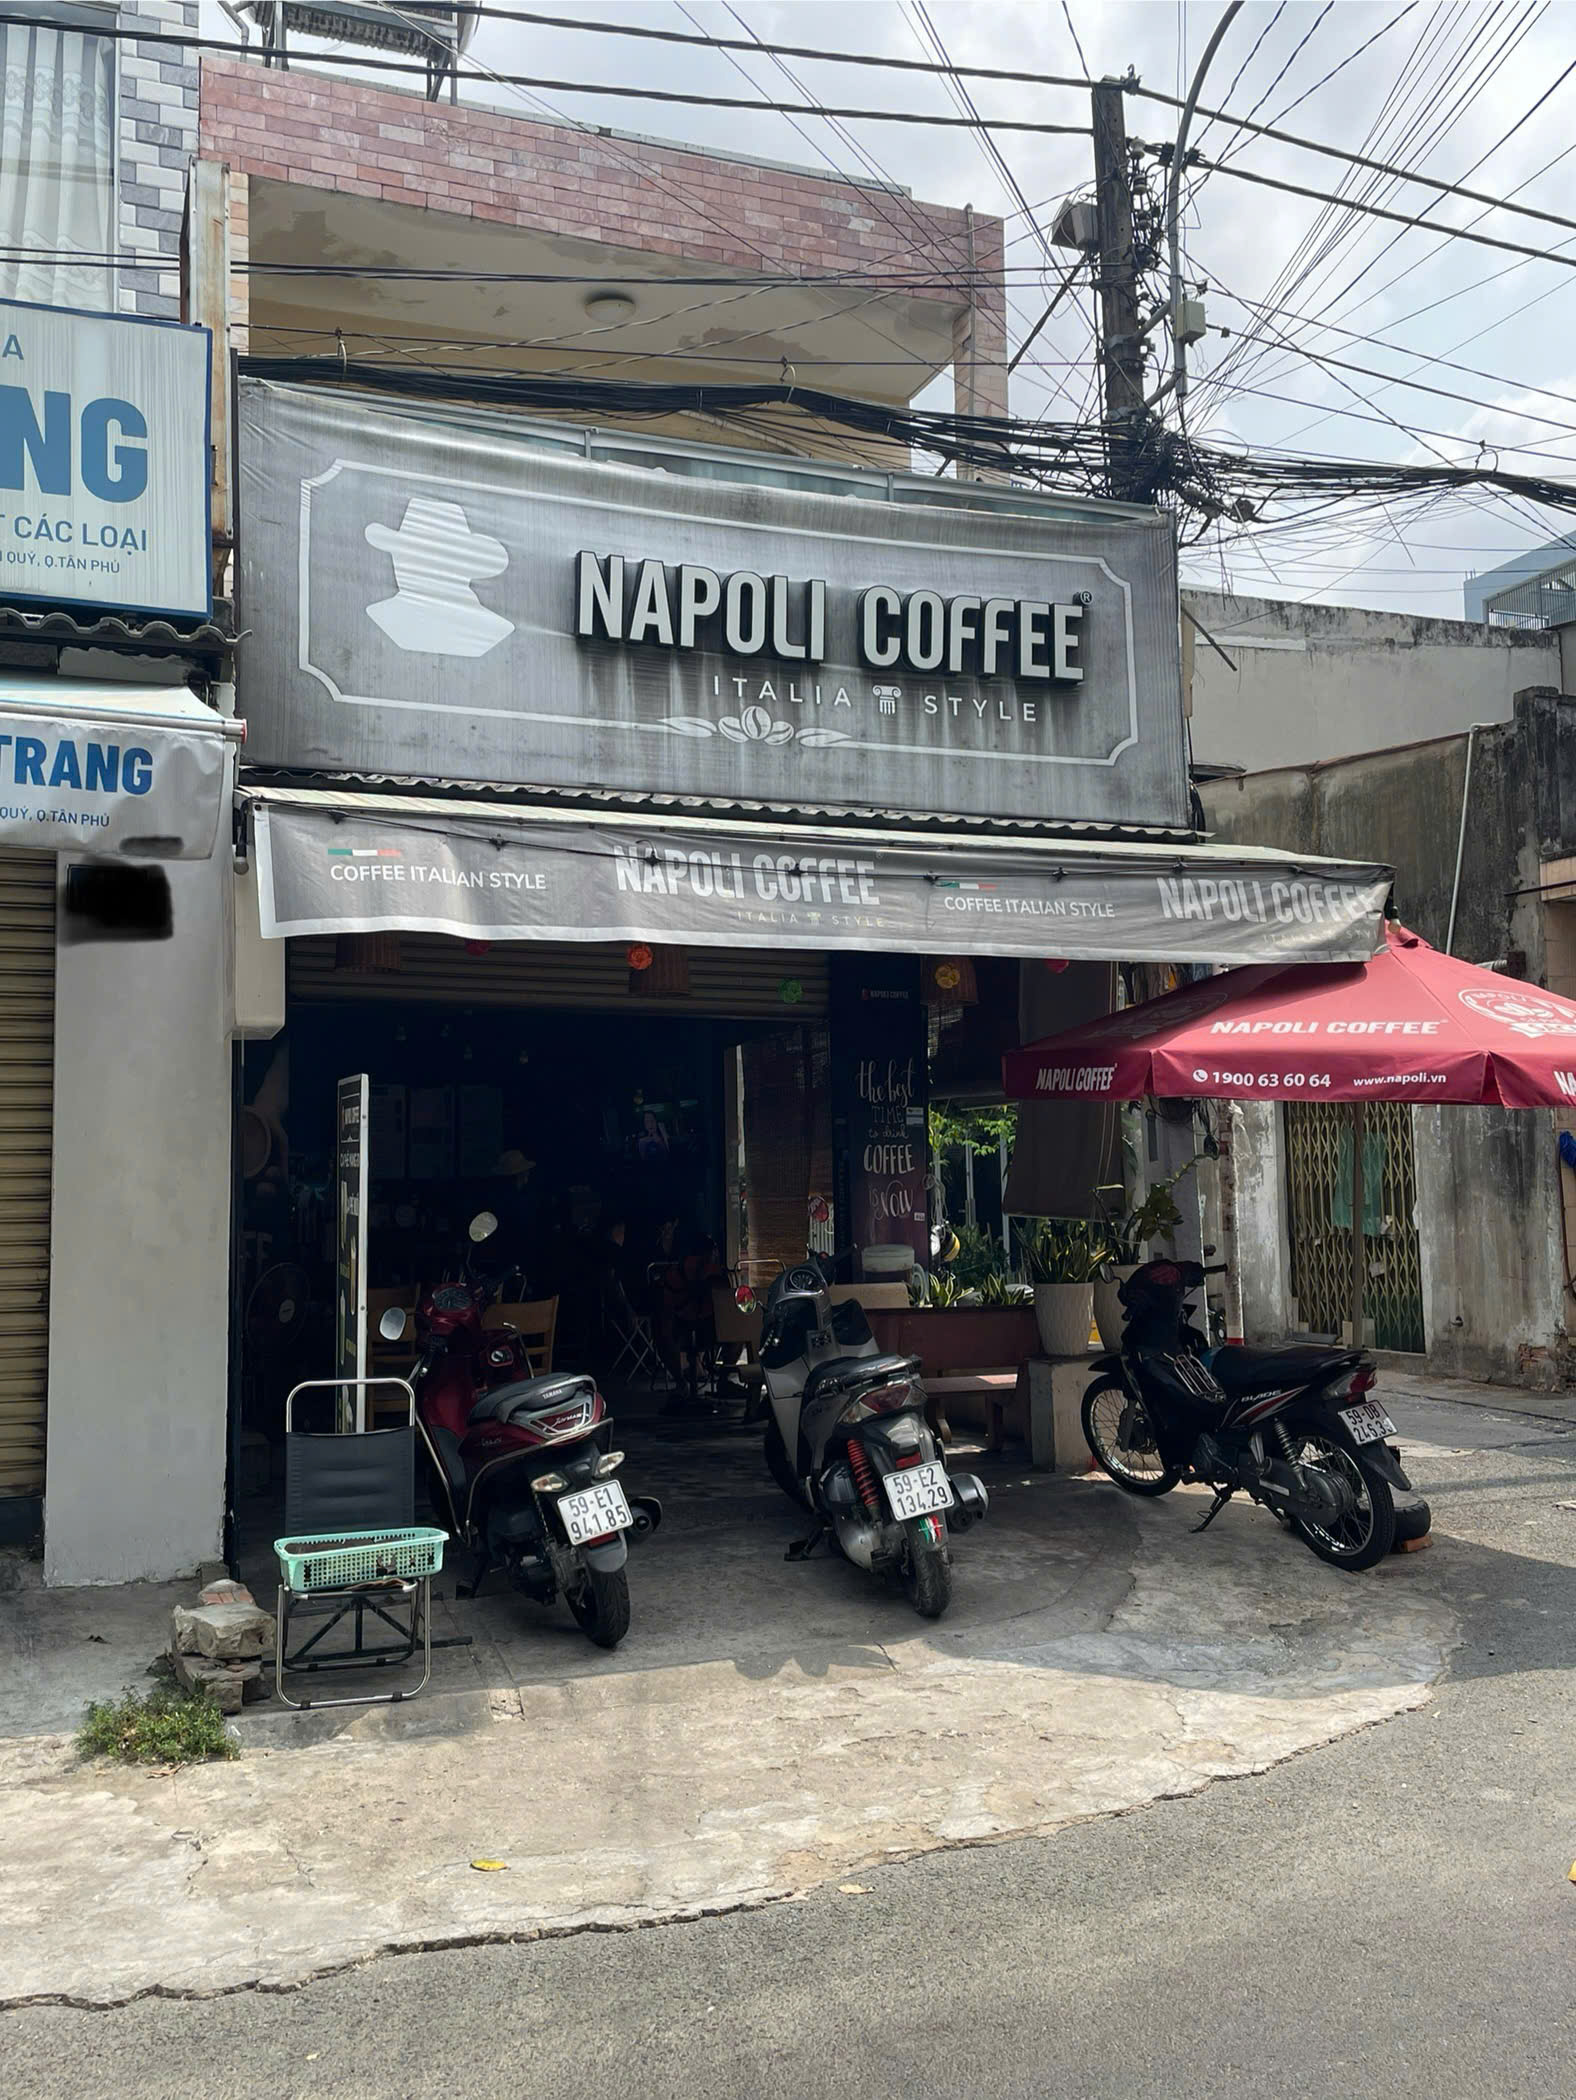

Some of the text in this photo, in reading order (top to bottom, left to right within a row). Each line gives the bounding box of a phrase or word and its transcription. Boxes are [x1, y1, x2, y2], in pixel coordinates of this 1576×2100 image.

[14, 513, 147, 556] CÁC LOẠI
[44, 554, 88, 570] Q.TÂN
[576, 550, 1085, 683] NAPOLI COFFEE
[714, 675, 1037, 723] ITALIA STYLE
[37, 809, 78, 826] Q.TÂN
[330, 864, 547, 890] COFFEE ITALIAN STYLE
[613, 845, 881, 906] NAPOLI COFFEE
[944, 896, 1116, 918] COFFEE ITALIAN STYLE
[1156, 877, 1267, 924] NAPOLI
[738, 910, 886, 929] ITALIA STYLE
[1209, 1020, 1440, 1035] NAPOLI COFFEE
[856, 1059, 886, 1104] the
[1035, 1066, 1115, 1091] NAPOLI COFFEE
[1212, 1071, 1332, 1088] 1900 63 60 64
[1352, 1071, 1447, 1087] www.napoli.vn
[863, 1143, 915, 1176] COFFEE
[1240, 1389, 1282, 1403] BLADE
[893, 1467, 938, 1495] 59-E2
[568, 1487, 613, 1517] 59-E1
[897, 1485, 948, 1516] 134.29
[570, 1504, 627, 1540] 941.85
